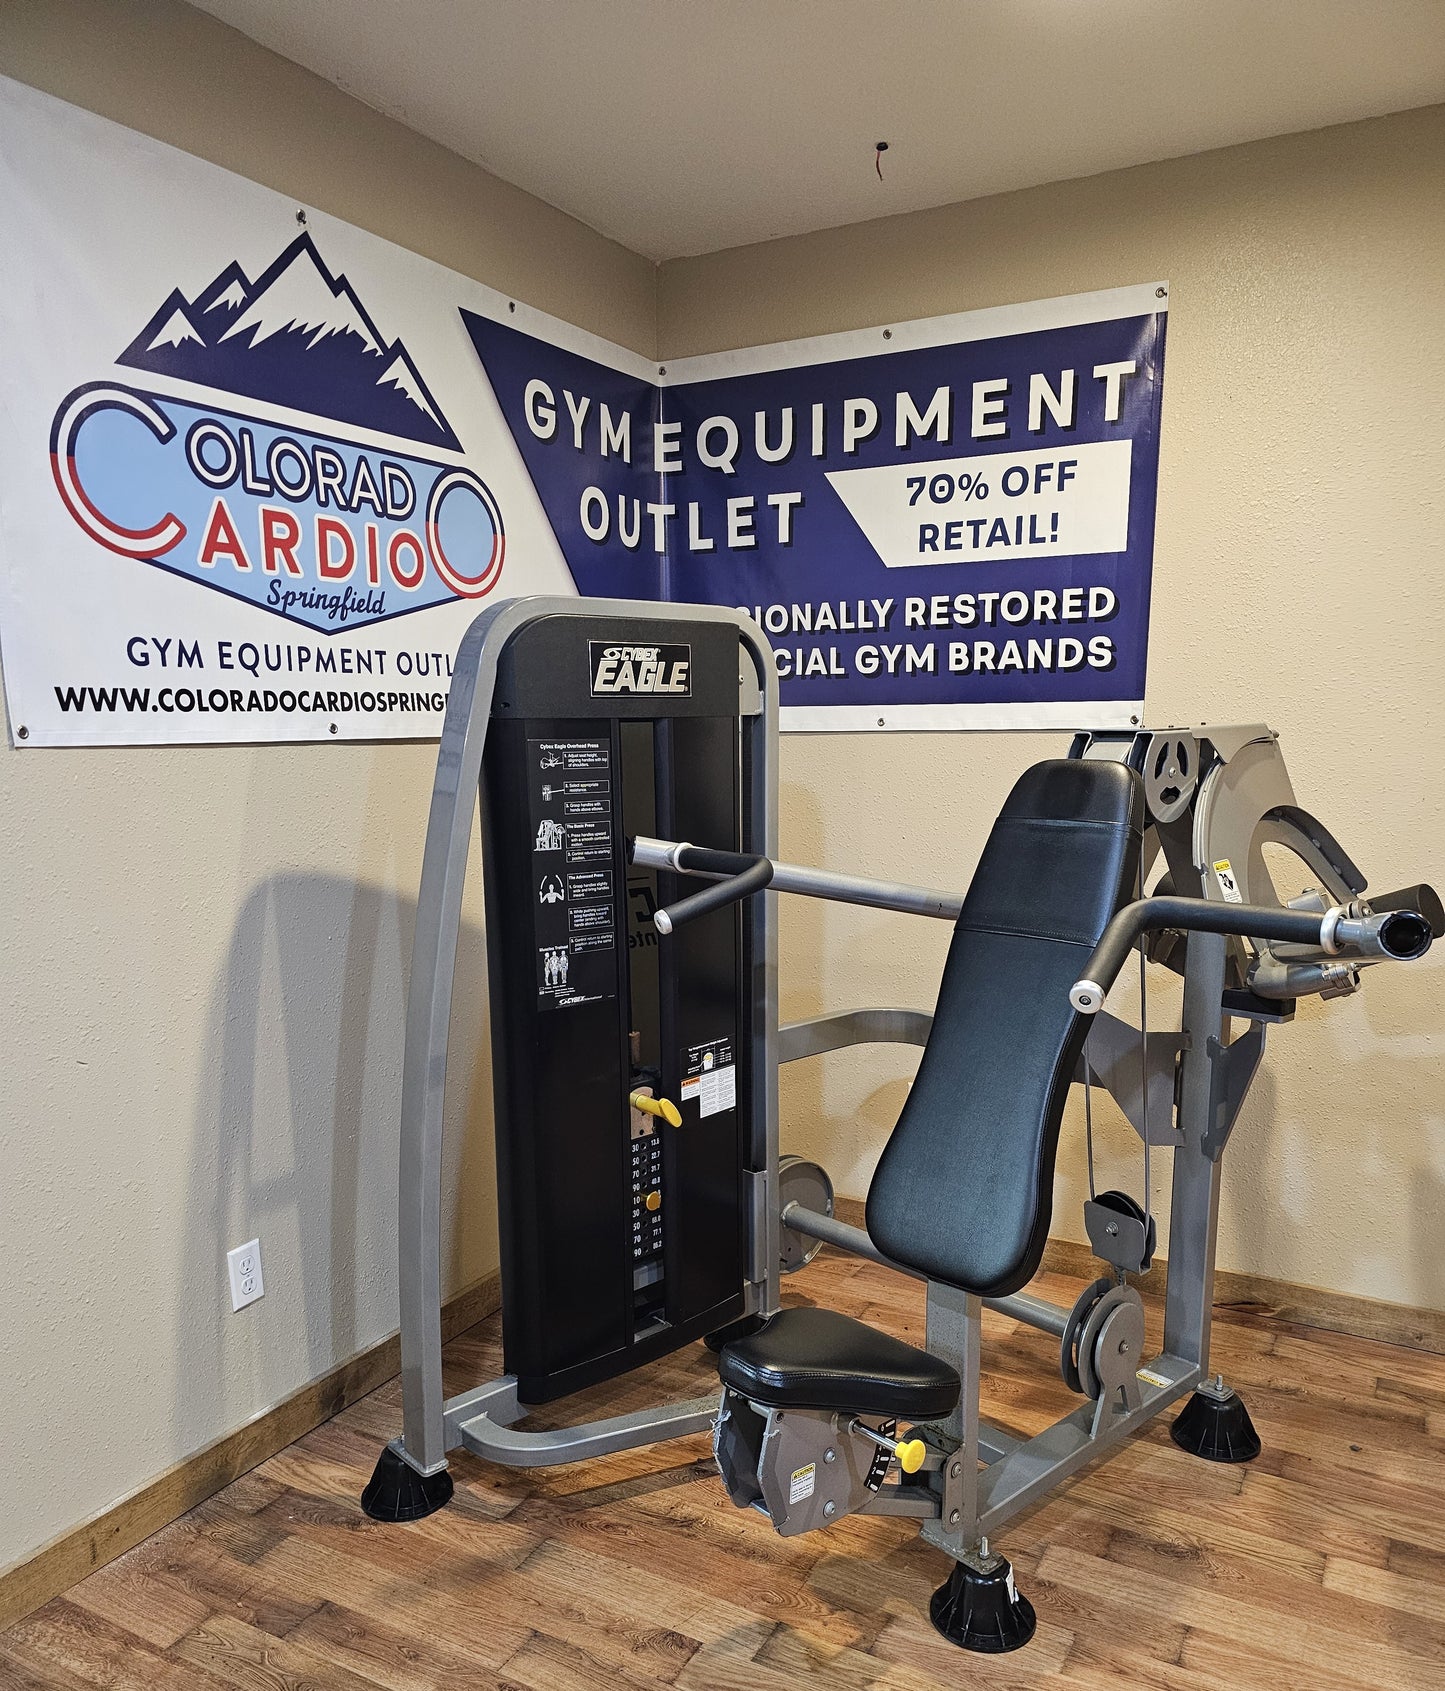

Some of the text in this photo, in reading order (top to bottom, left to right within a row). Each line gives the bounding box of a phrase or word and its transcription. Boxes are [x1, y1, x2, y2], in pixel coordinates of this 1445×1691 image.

[524, 360, 1137, 474] GYM EQUIPMENT
[50, 381, 505, 599] COLORADO
[906, 460, 1078, 506] 70% OFF
[580, 486, 803, 553] OUTLET
[918, 512, 1059, 552] RETAIL!
[267, 579, 386, 621] Springfield
[905, 586, 1116, 628] RESTORED
[127, 636, 454, 677] GYM EQUIPMENT OUTL
[620, 647, 660, 661] CYBEX
[855, 643, 935, 675] GYM
[948, 635, 1113, 672] BRANDS
[593, 661, 688, 692] EAGLE
[632, 1144, 639, 1152] 30
[632, 1157, 640, 1165] 50
[633, 1170, 640, 1178] 70
[633, 1183, 640, 1192] 90
[876, 1454, 880, 1463] 3
